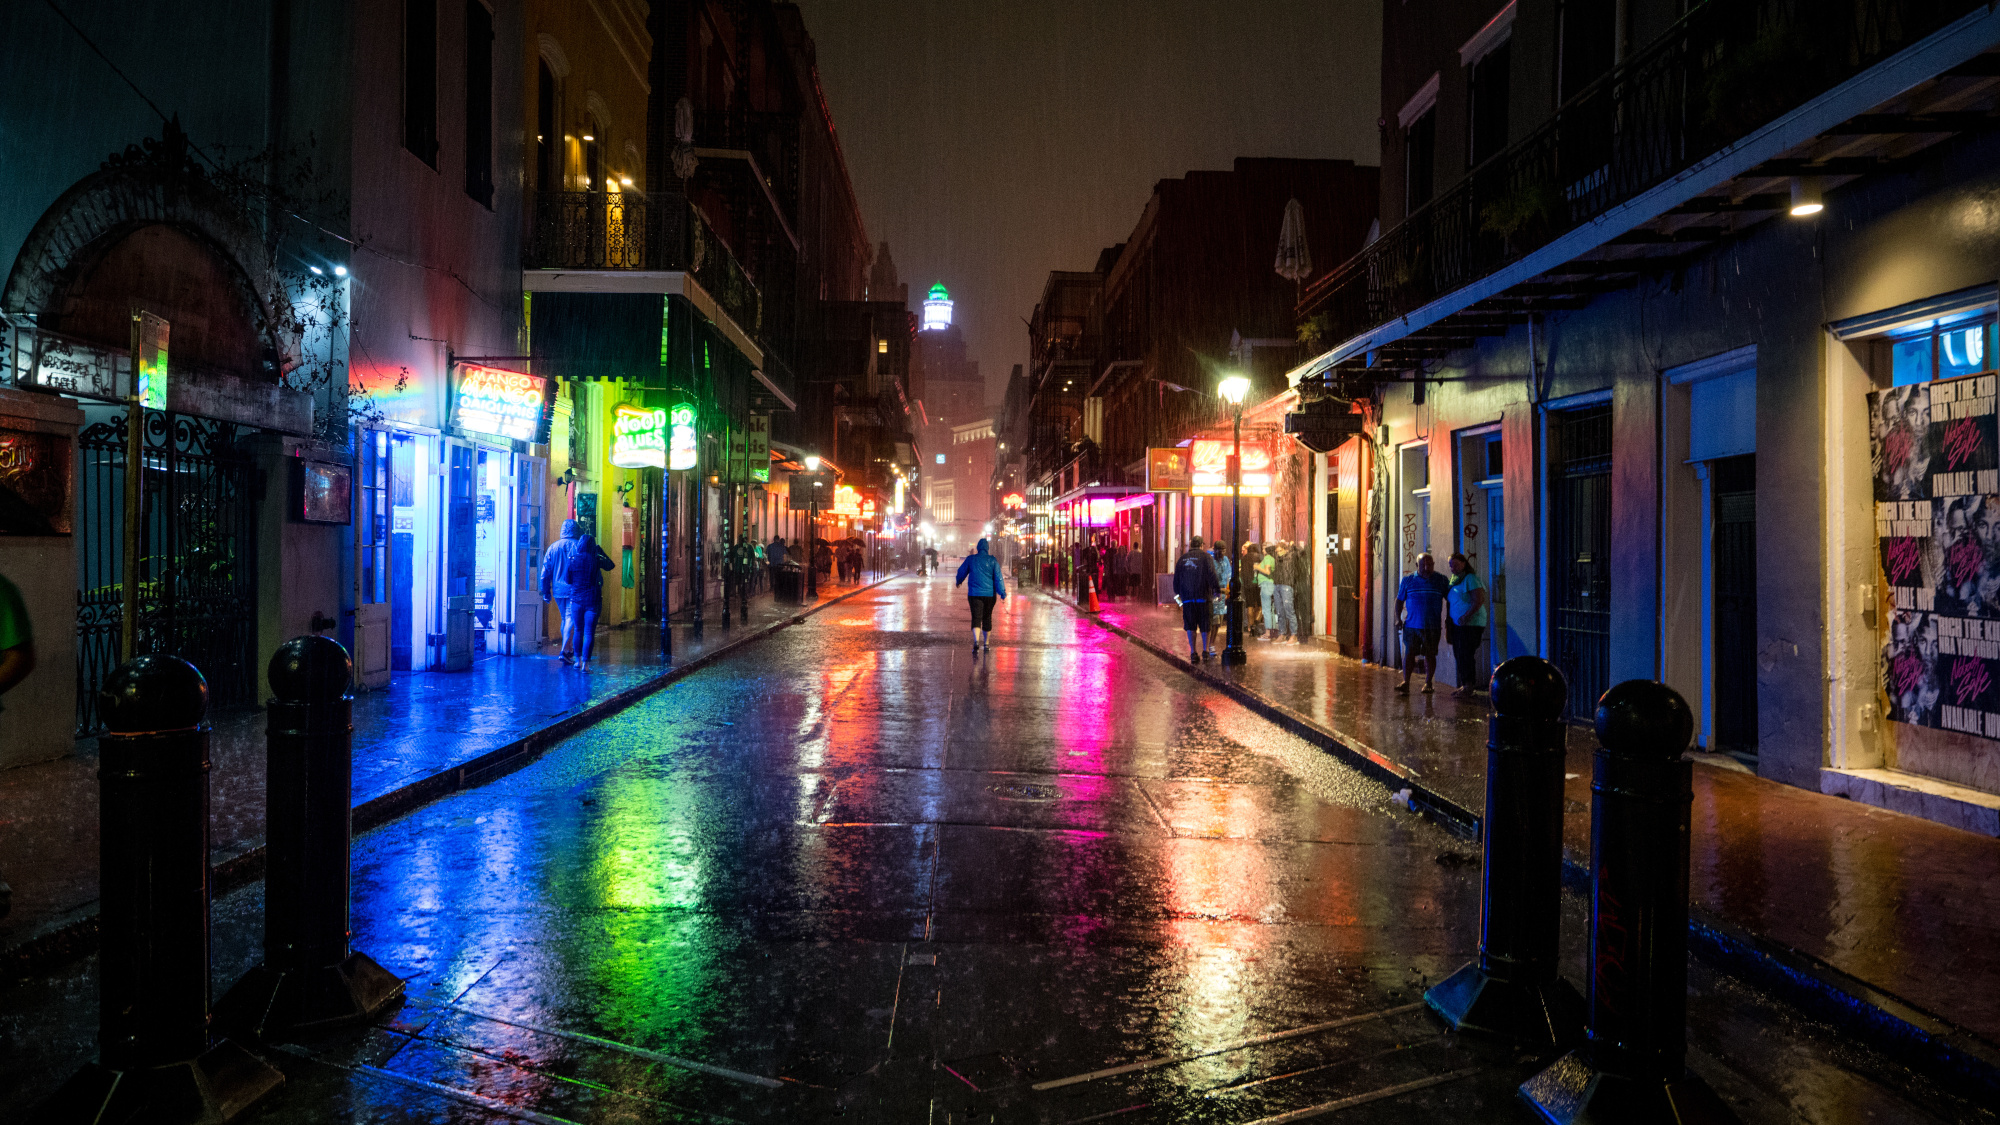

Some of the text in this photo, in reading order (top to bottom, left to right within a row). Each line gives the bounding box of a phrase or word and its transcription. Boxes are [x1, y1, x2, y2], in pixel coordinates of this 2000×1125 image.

[473, 370, 531, 388] MANGO
[1930, 374, 1997, 405] RICH THE KID
[460, 378, 541, 407] MANGO
[460, 396, 536, 419] DAIQUIRIS
[1931, 395, 1996, 423] NBA YOUNGBOY
[616, 429, 664, 451] BLUES
[1932, 469, 1998, 498] AVAILABLE NOW
[1898, 501, 1915, 520] THE
[1915, 500, 1932, 520] KID
[1938, 616, 1962, 637] RICH
[1963, 619, 1983, 640] THE
[1938, 636, 1956, 655] NBA
[1941, 704, 1983, 735] AVAILABLE
